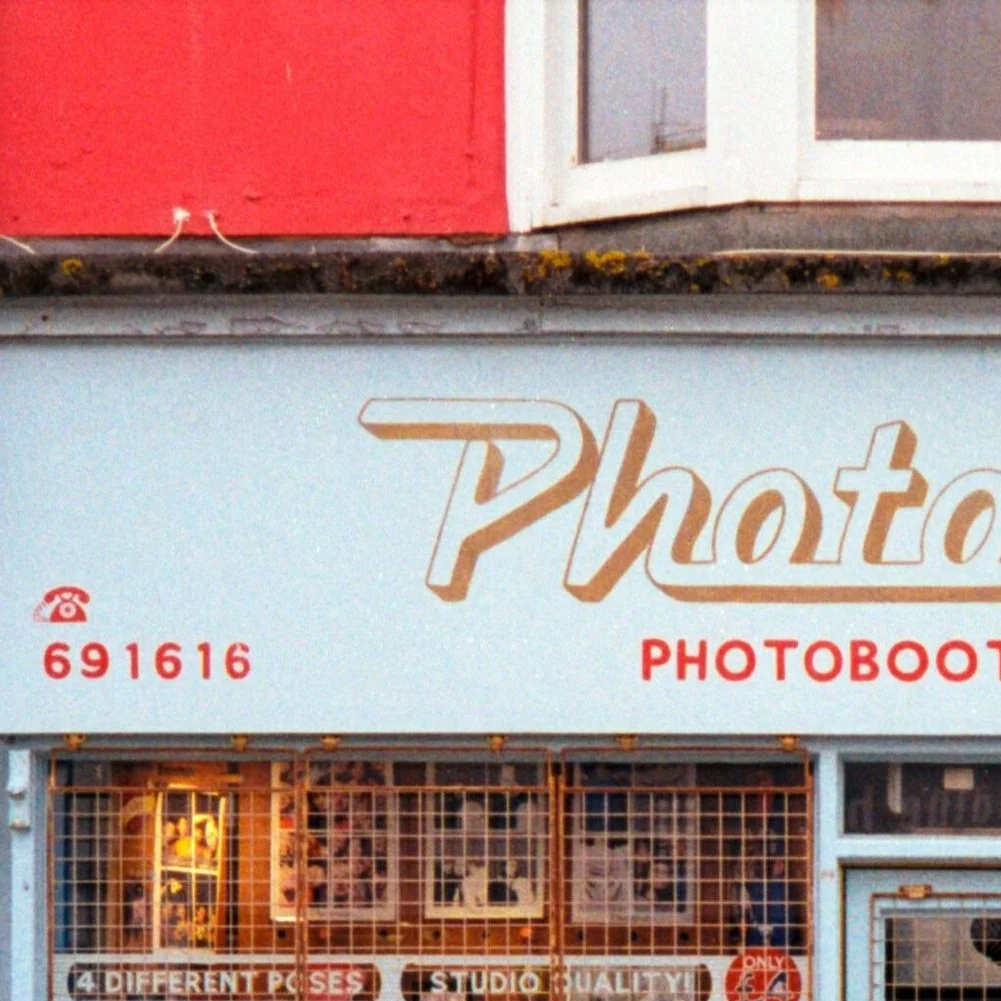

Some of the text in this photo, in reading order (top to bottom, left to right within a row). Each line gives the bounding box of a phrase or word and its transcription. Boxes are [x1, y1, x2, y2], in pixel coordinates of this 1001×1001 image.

[42, 641, 251, 680] 691616
[743, 955, 786, 970] ONLY
[76, 970, 364, 995] 4 DIFFERENT POSES
[430, 970, 541, 995] STUDIO
